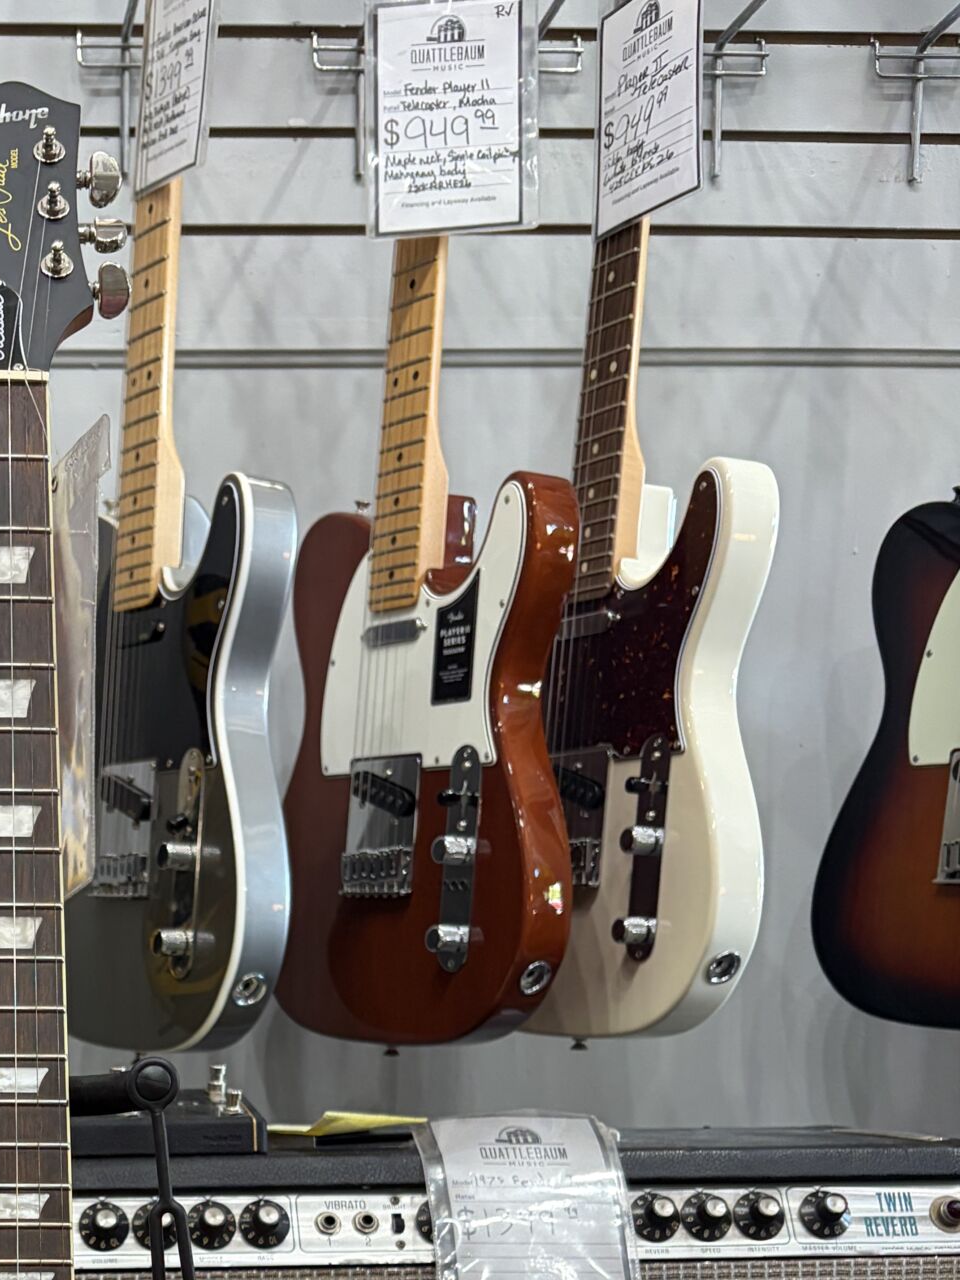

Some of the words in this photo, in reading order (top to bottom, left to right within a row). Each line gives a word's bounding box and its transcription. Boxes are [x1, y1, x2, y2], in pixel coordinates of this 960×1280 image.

[622, 16, 673, 61] QUATTLEBAUM
[411, 45, 485, 64] QUATTLEBAUM
[404, 81, 438, 95] Fender
[443, 82, 477, 98] Player
[459, 95, 496, 108] Mocha
[384, 115, 469, 148] $949
[604, 95, 655, 150] $949
[10, 148, 18, 169] MODEL
[440, 627, 465, 637] PLAYER
[444, 636, 466, 647] SERIES
[480, 1147, 568, 1160] QUATTLEBAUM
[324, 1200, 367, 1210] VIBRATO
[875, 1191, 914, 1213] TWIN
[864, 1215, 919, 1238] REVERB
